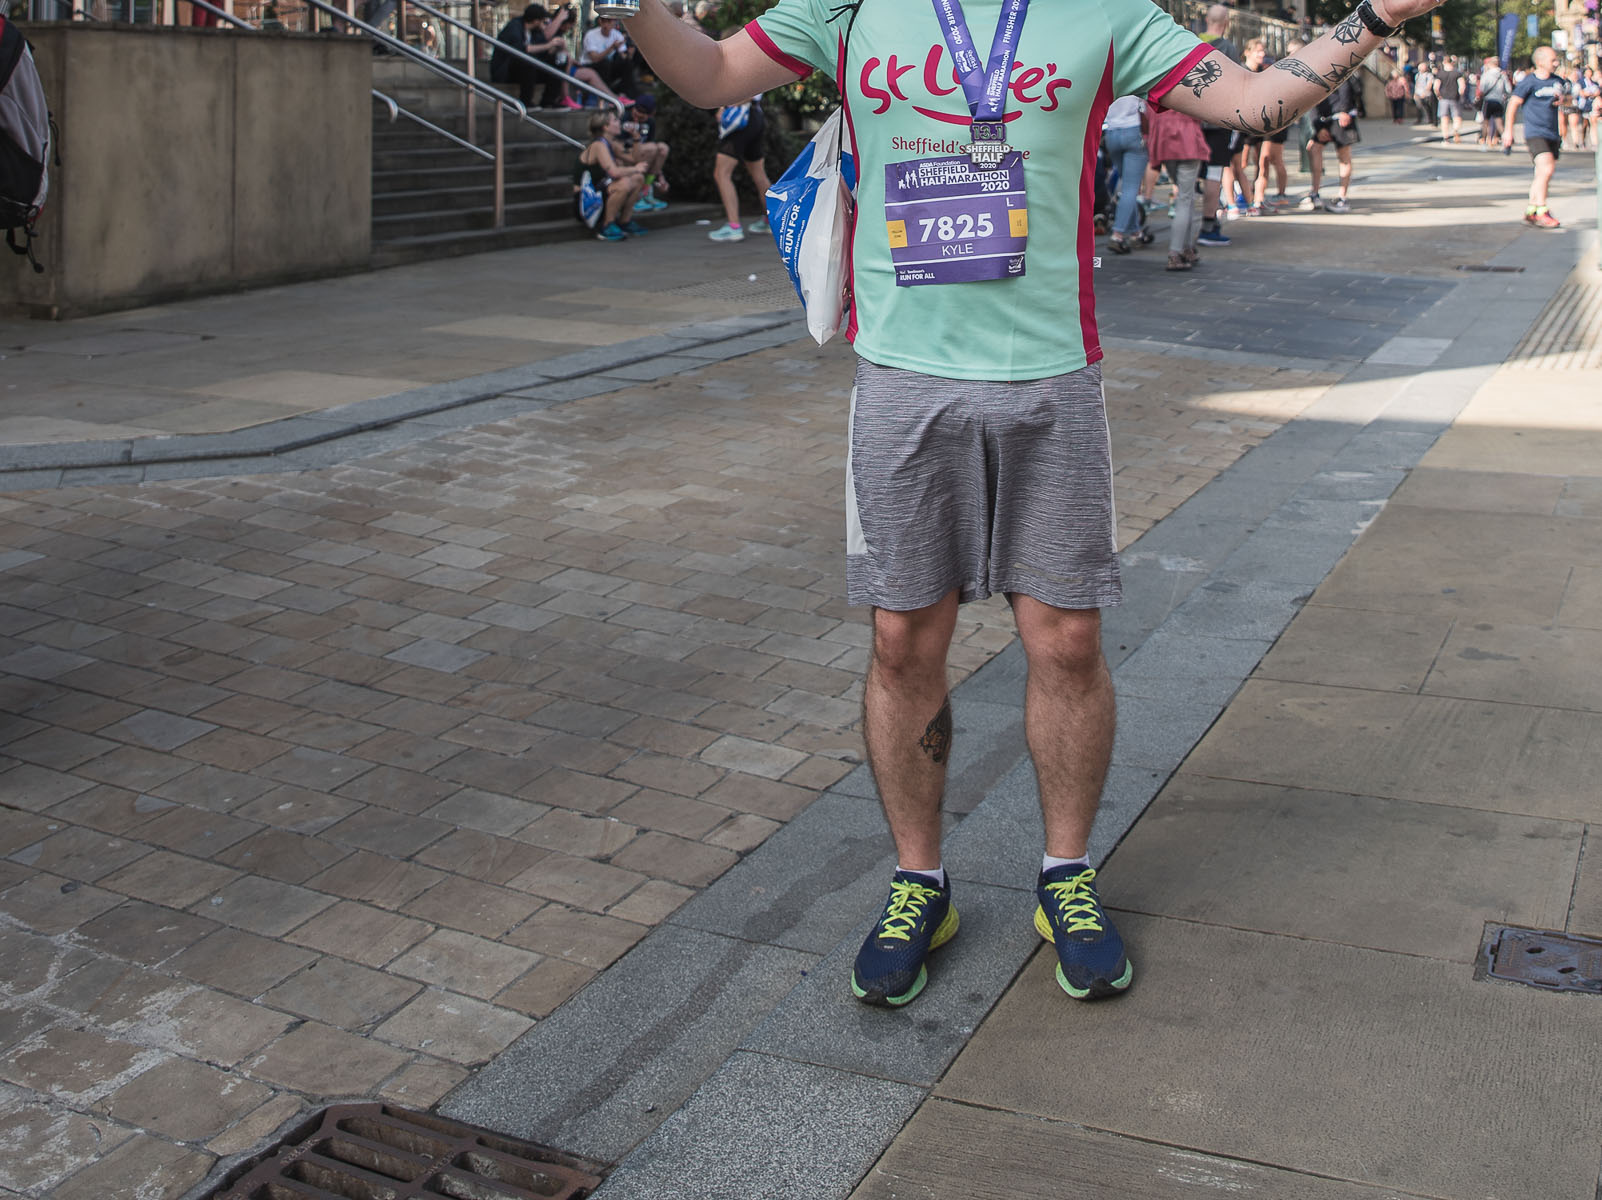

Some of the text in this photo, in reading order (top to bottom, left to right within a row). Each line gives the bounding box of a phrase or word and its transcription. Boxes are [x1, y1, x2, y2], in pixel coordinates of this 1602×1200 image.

[950, 25, 963, 45] 2020
[1003, 11, 1018, 44] FINISHER
[999, 49, 1011, 83] MARATHON
[860, 54, 917, 114] St
[989, 69, 1000, 97] SHEFFIELD
[973, 125, 1004, 140] 13.1
[892, 137, 966, 154] Sheffield's
[966, 144, 1011, 153] SHEFFIELD
[972, 153, 1004, 163] HALF
[920, 165, 967, 177] SHEFFIELD
[920, 171, 1008, 187] HALF MARATHON
[981, 181, 1010, 192] 2020
[1006, 197, 1014, 207] L
[785, 204, 801, 254] RUN FOR
[919, 213, 994, 242] 7825
[942, 243, 974, 256] KYLE
